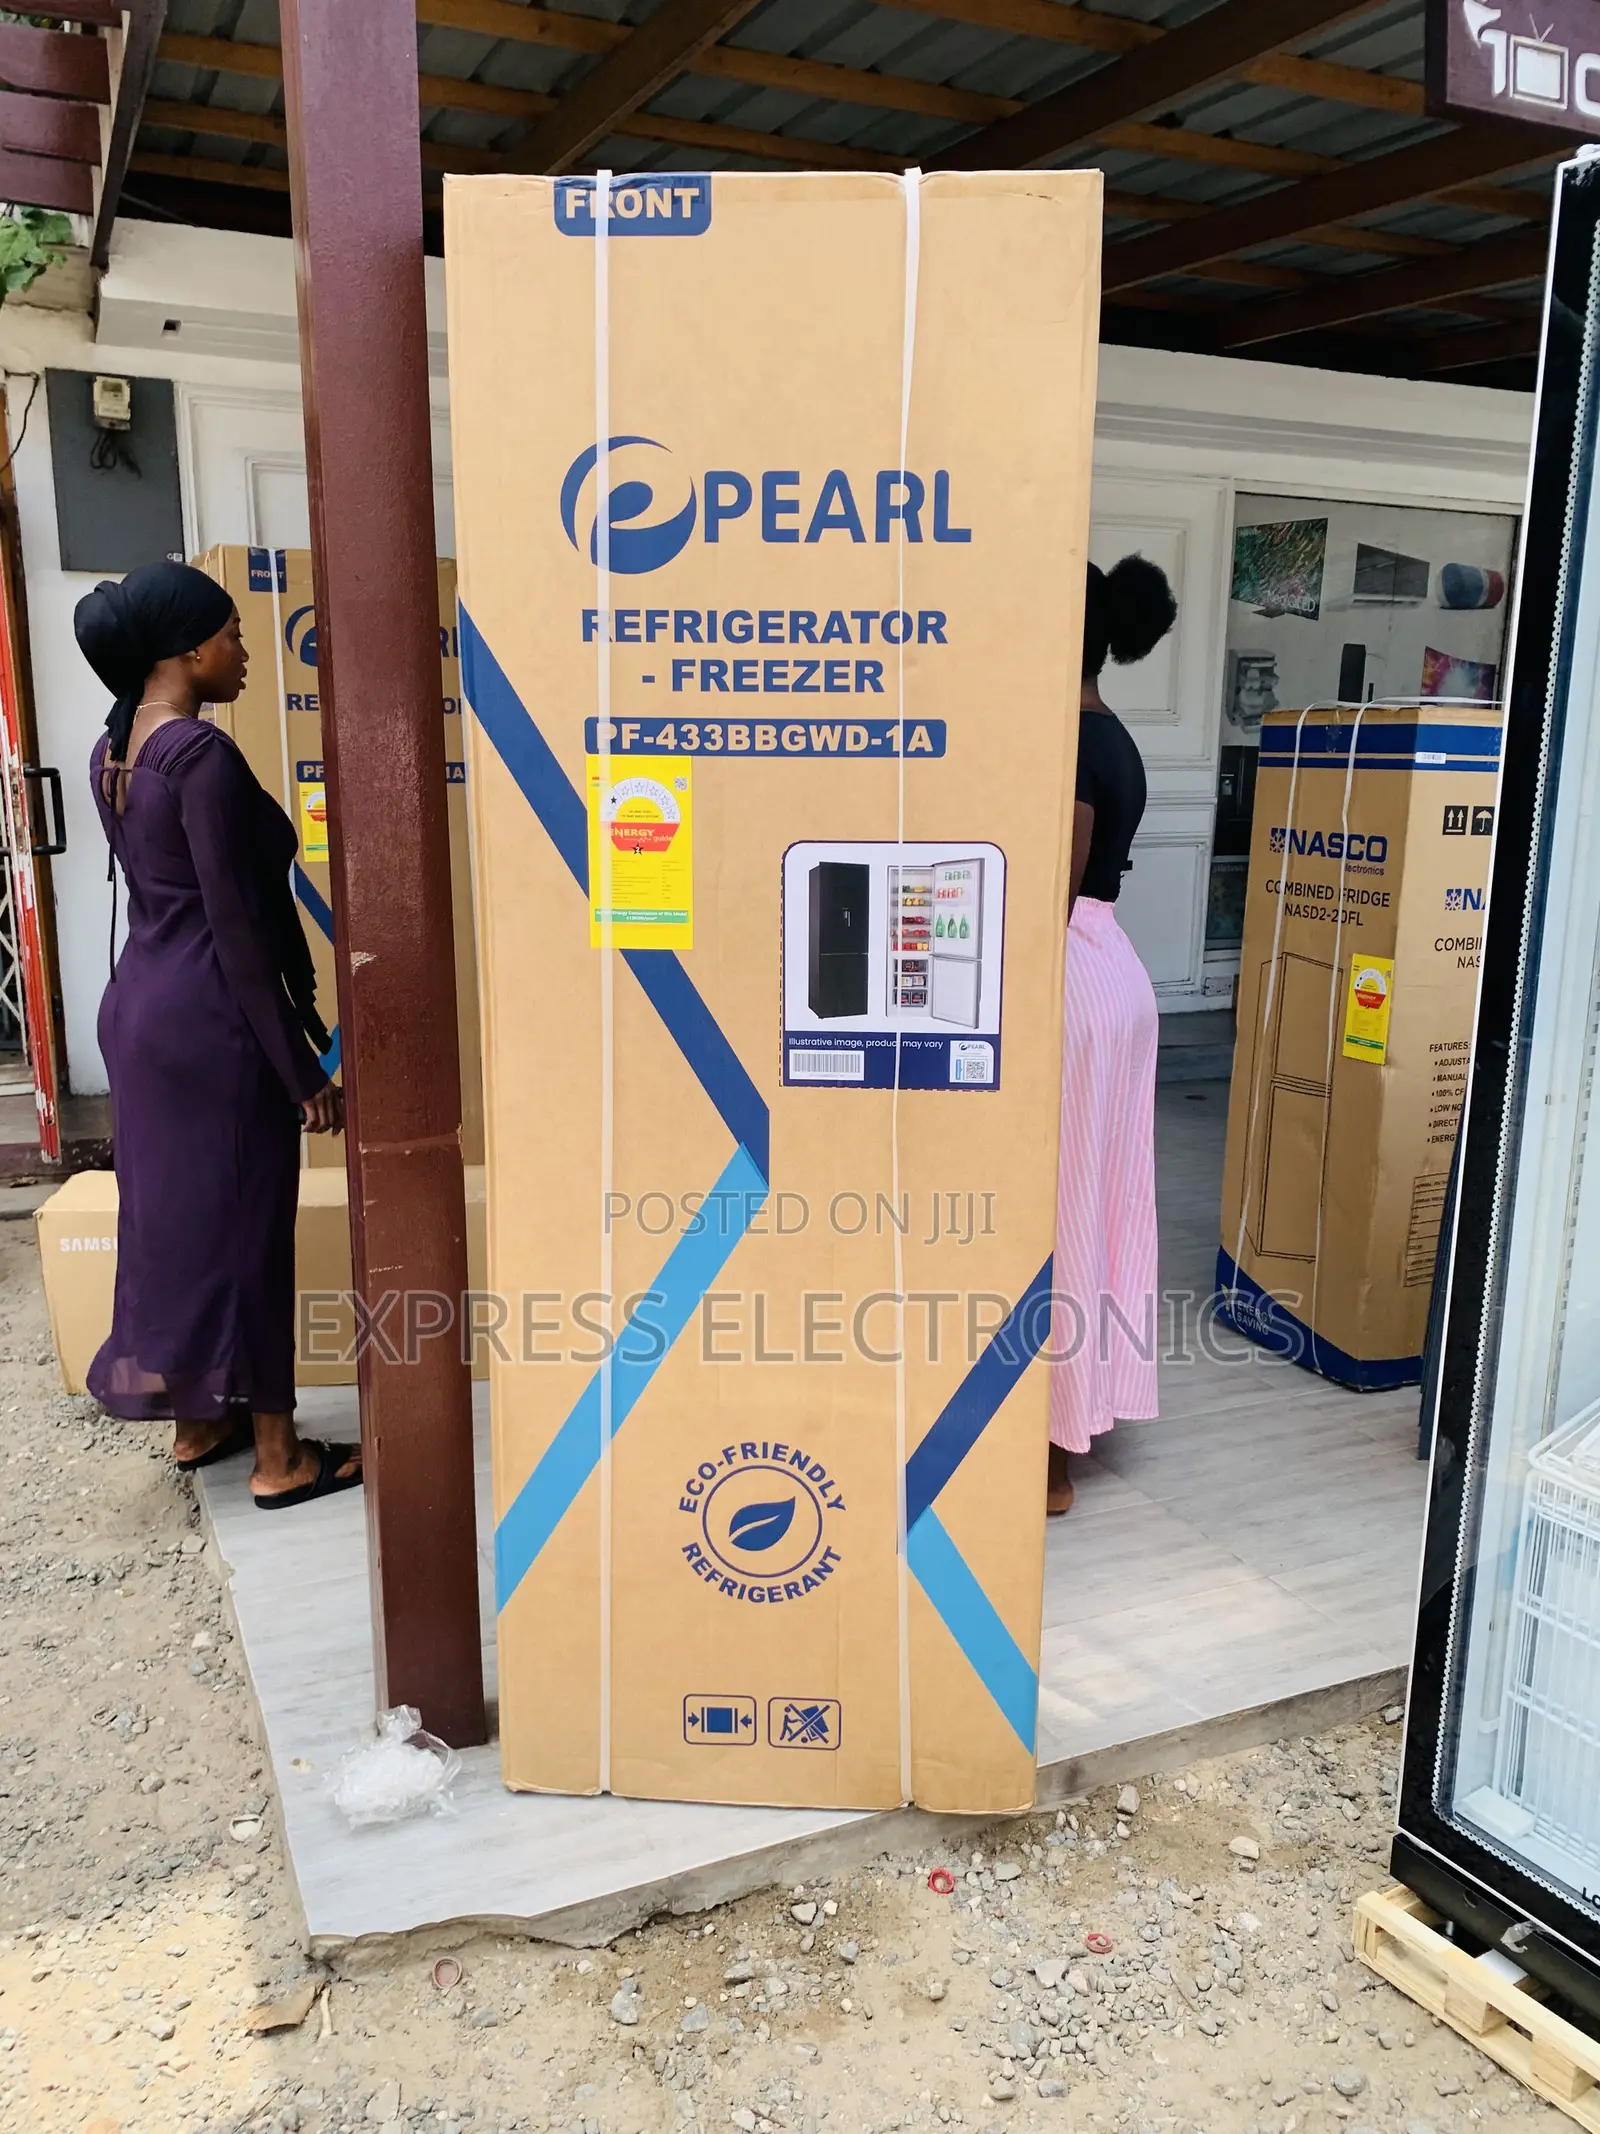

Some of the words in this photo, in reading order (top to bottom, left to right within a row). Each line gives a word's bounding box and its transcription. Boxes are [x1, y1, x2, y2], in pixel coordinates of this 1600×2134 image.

[566, 188, 700, 219] FRONT
[704, 469, 972, 543] PEARL
[582, 609, 949, 644] REFRIGERATOR
[671, 659, 884, 693] FREEZER
[597, 722, 934, 753] PF-433BBGWD-1A
[1288, 829, 1388, 863] NASCO
[1265, 879, 1335, 901] COMBINED
[1338, 887, 1391, 908] FRIDGE
[1284, 902, 1364, 926] NASD2-20FL
[788, 1037, 832, 1047] Illustrative
[834, 1038, 864, 1049] image,
[902, 1040, 922, 1050] may
[924, 1040, 943, 1050] vary
[1434, 1104, 1450, 1113] LOW
[1236, 1312, 1269, 1335] SAVING
[1237, 1300, 1274, 1324] ENERGY
[679, 1441, 847, 1514] ECO-FRIENDLY
[681, 1541, 842, 1603] REFRIGERANT
